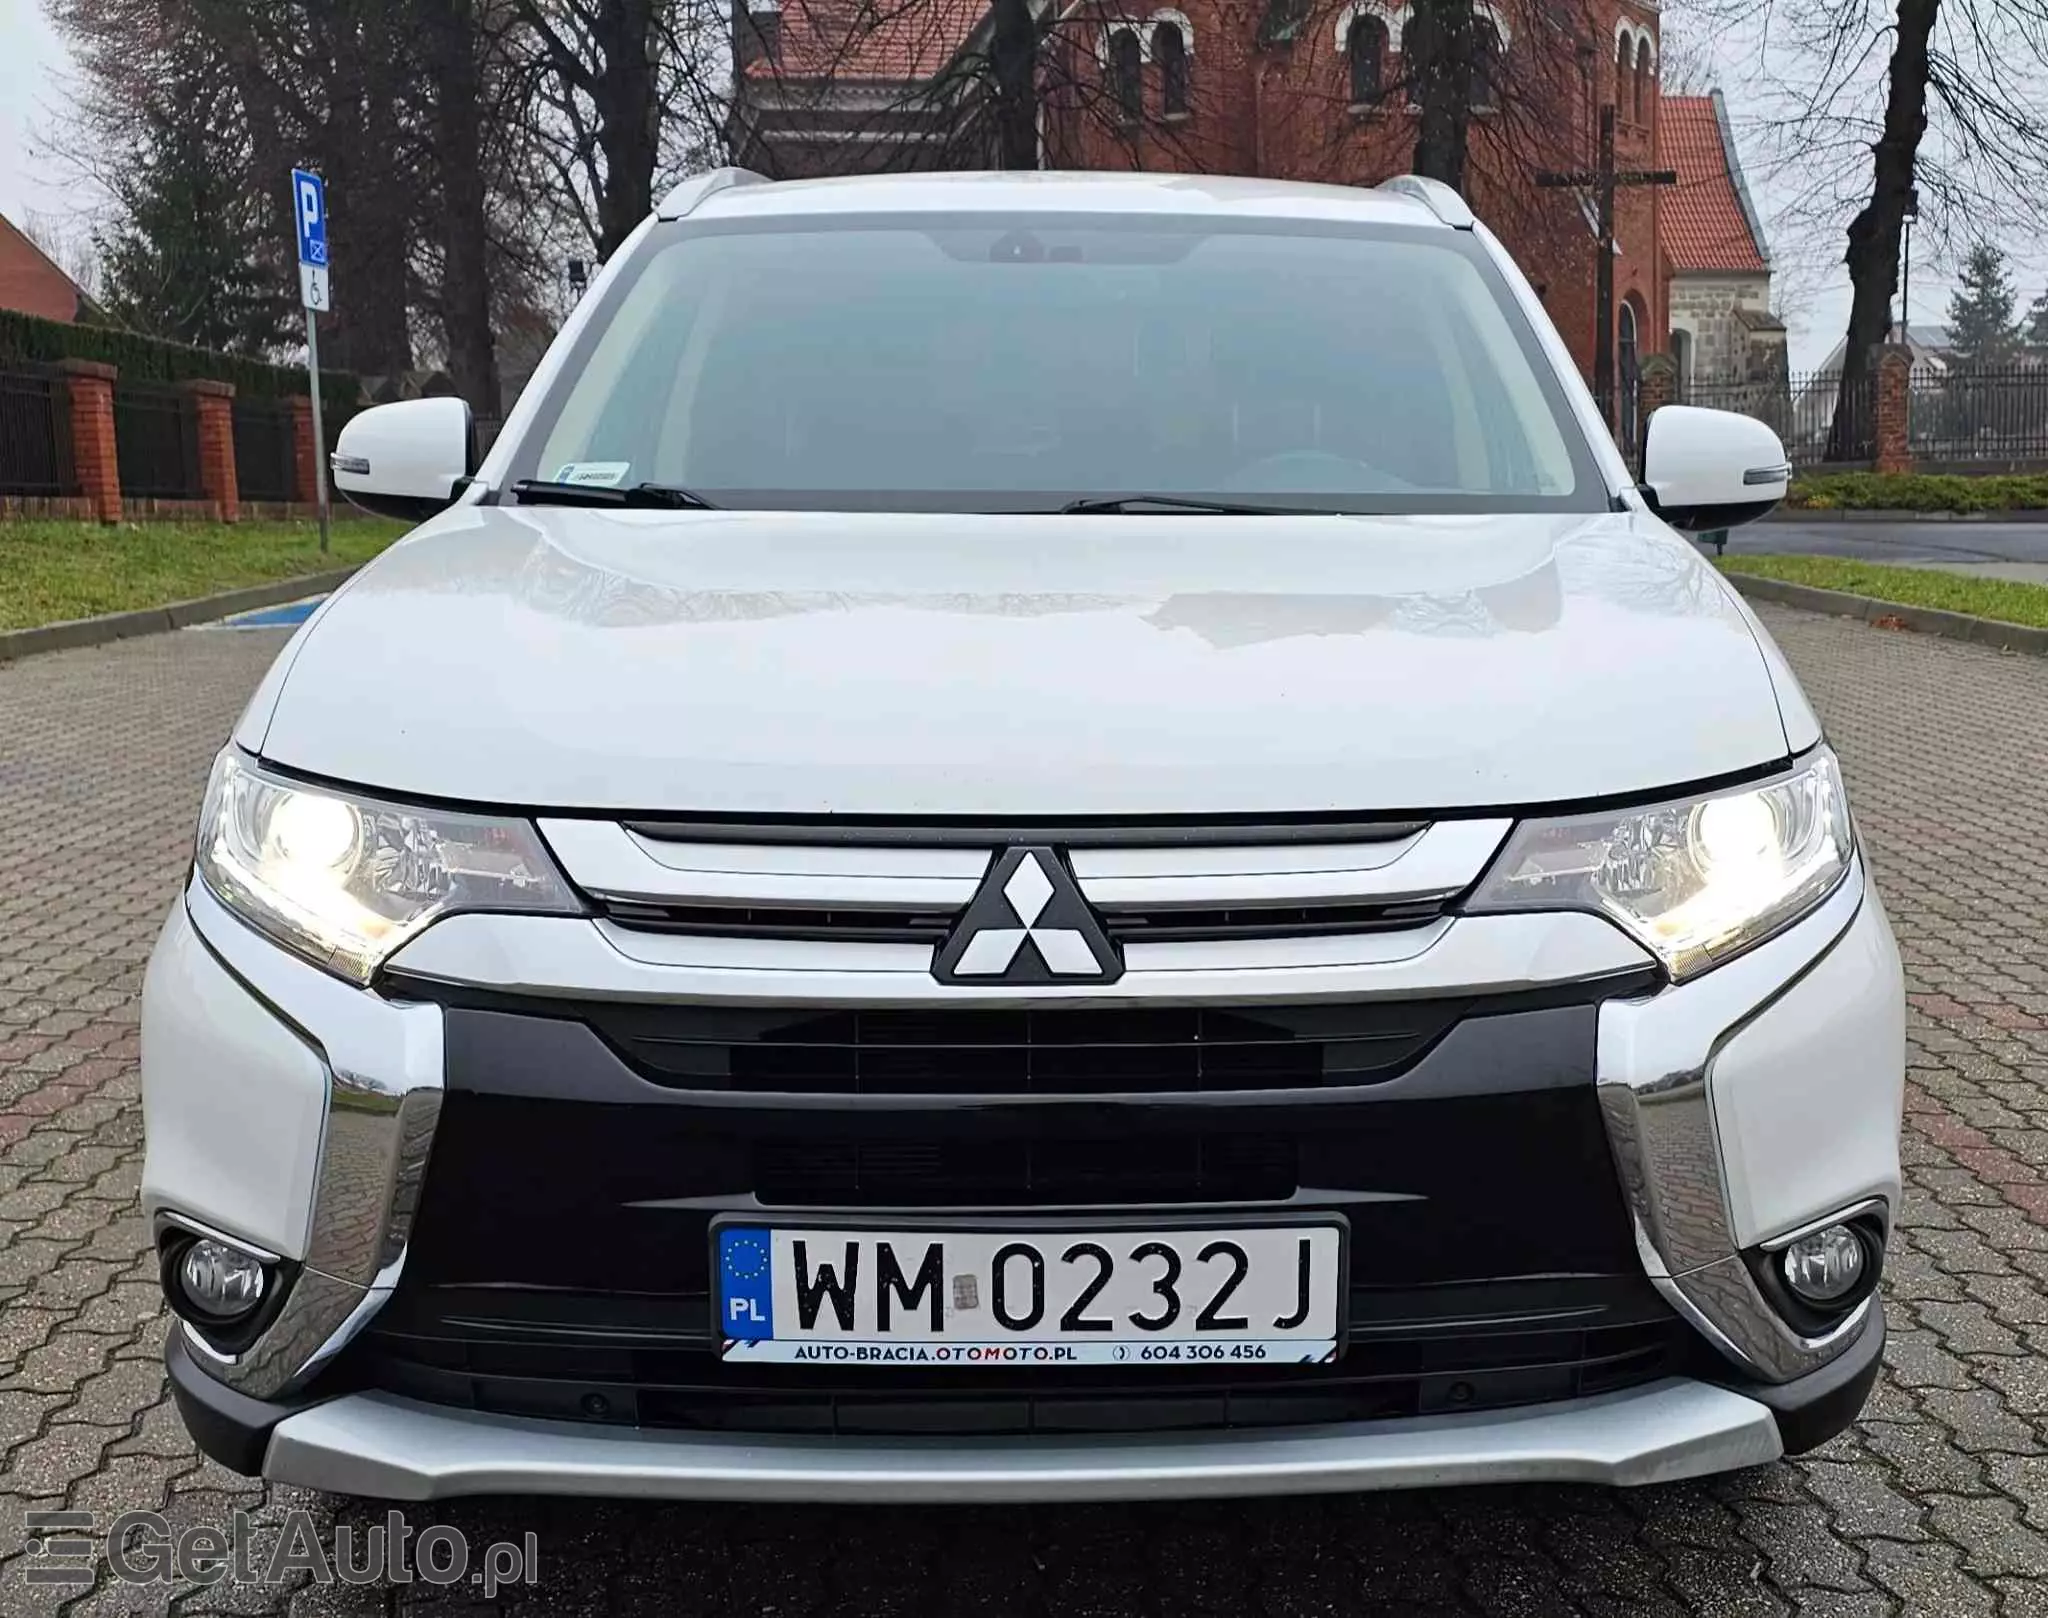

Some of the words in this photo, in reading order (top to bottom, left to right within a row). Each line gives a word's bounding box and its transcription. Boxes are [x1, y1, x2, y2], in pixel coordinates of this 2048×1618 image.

[300, 181, 319, 238] P
[792, 1240, 944, 1332] WM
[991, 1239, 1311, 1332] 0232J
[730, 1297, 766, 1321] PL
[794, 1346, 1077, 1361] AUTO-BRACIA.OTOMOTO.PL
[1140, 1345, 1180, 1360] 604
[1186, 1345, 1225, 1360] 306
[1230, 1344, 1266, 1359] 456
